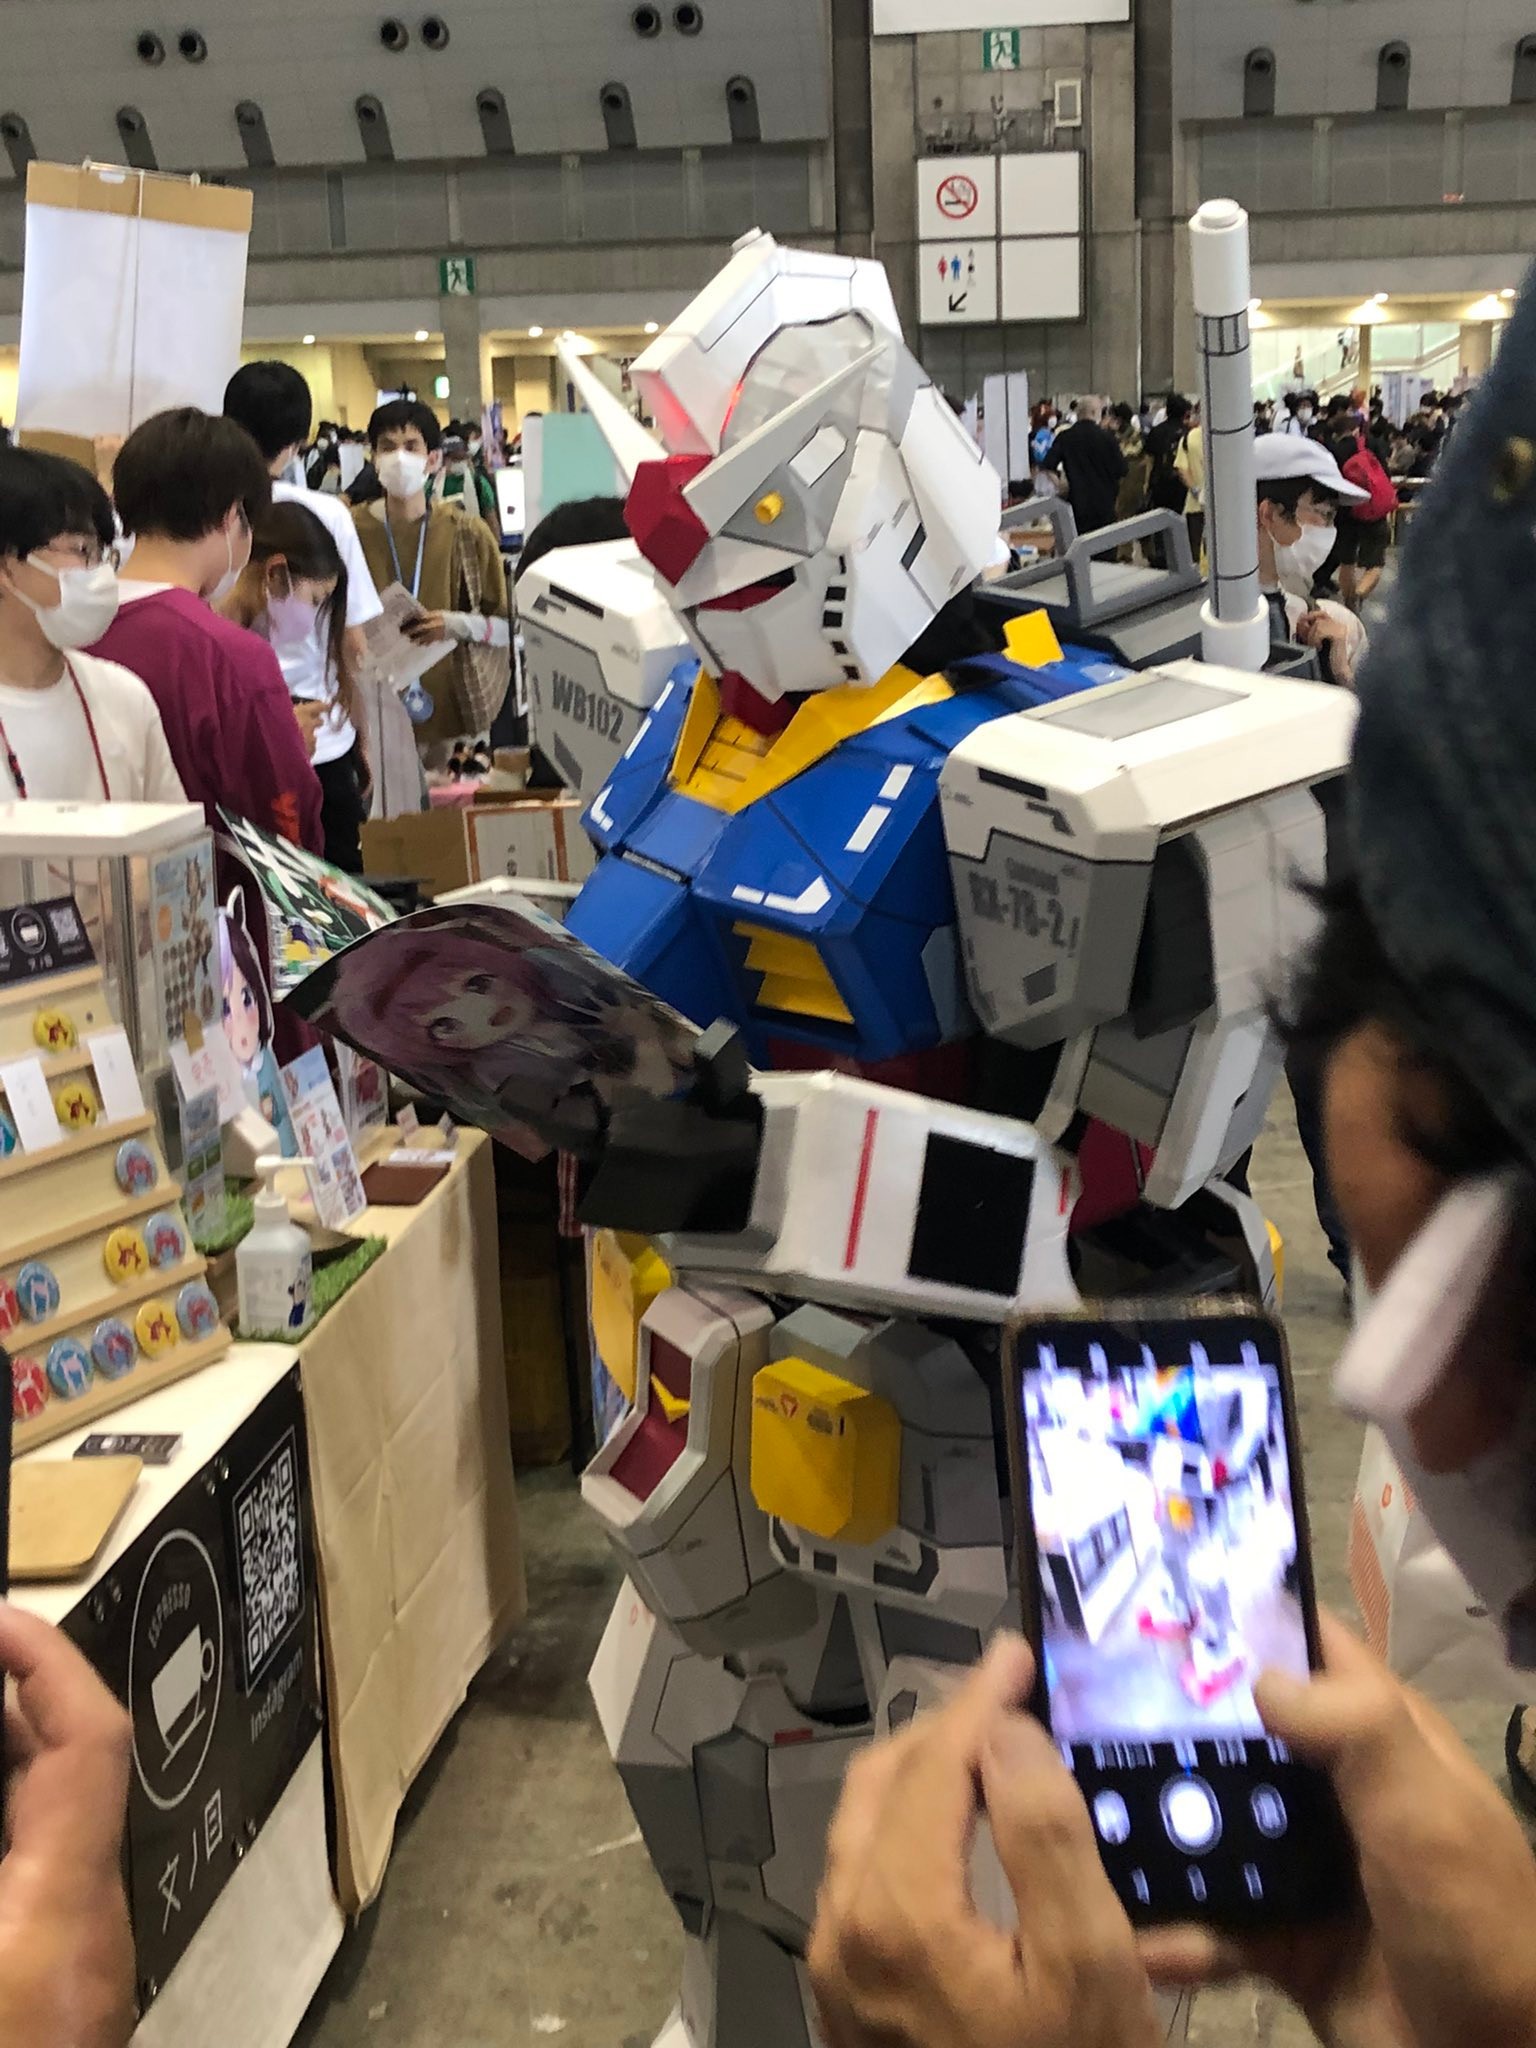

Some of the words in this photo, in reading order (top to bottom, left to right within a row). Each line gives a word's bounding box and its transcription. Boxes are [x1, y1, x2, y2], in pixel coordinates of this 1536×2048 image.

[553, 669, 624, 744] WB102
[149, 1582, 191, 1649] ESPRESSO
[250, 1646, 303, 1744] Instagram
